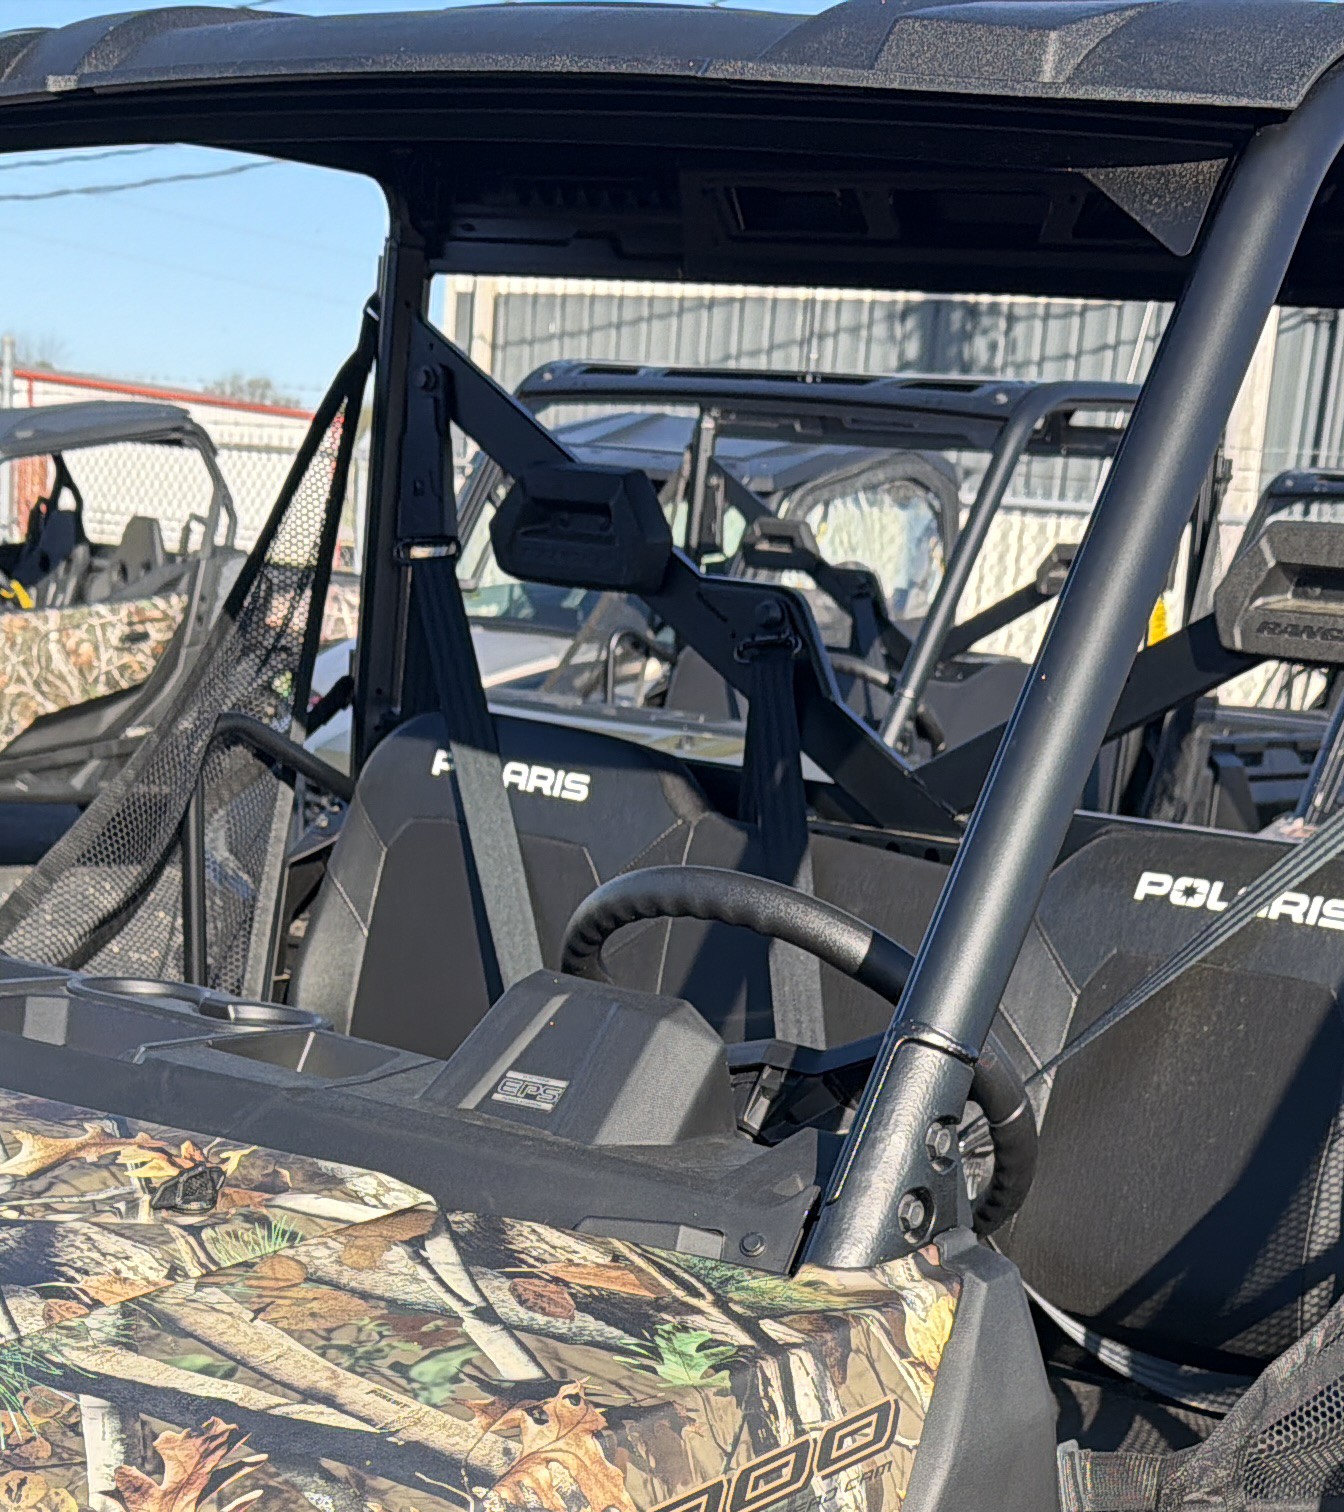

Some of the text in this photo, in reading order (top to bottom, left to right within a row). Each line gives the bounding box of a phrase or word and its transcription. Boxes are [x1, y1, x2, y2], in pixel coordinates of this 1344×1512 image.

[431, 748, 591, 802] PARIS
[497, 1078, 565, 1103] EPS
[844, 1460, 893, 1492] CAM
